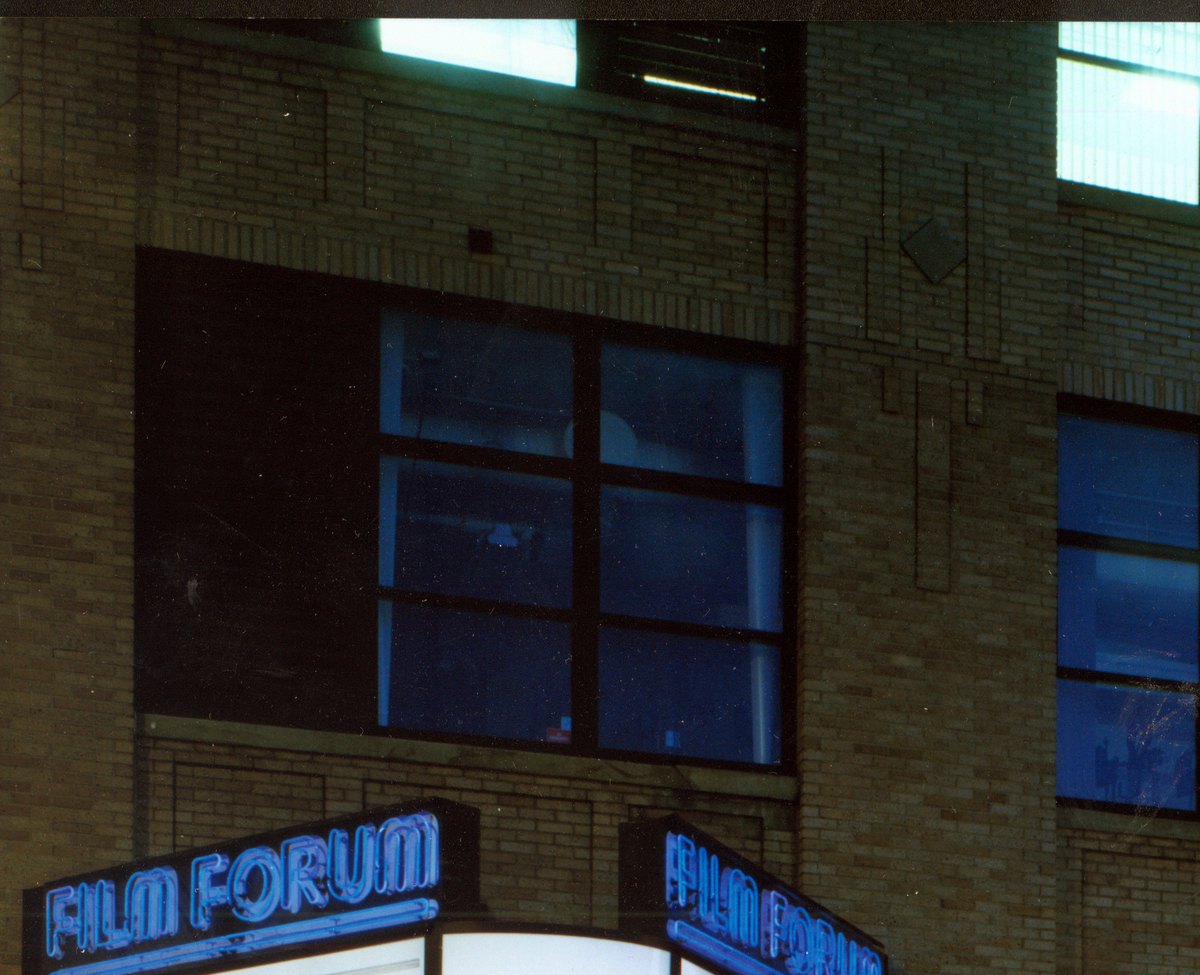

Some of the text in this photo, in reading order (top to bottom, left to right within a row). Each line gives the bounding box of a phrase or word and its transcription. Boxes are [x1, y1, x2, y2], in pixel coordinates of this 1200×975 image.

[47, 811, 440, 959] FILM FORUM
[666, 831, 759, 948] FILM
